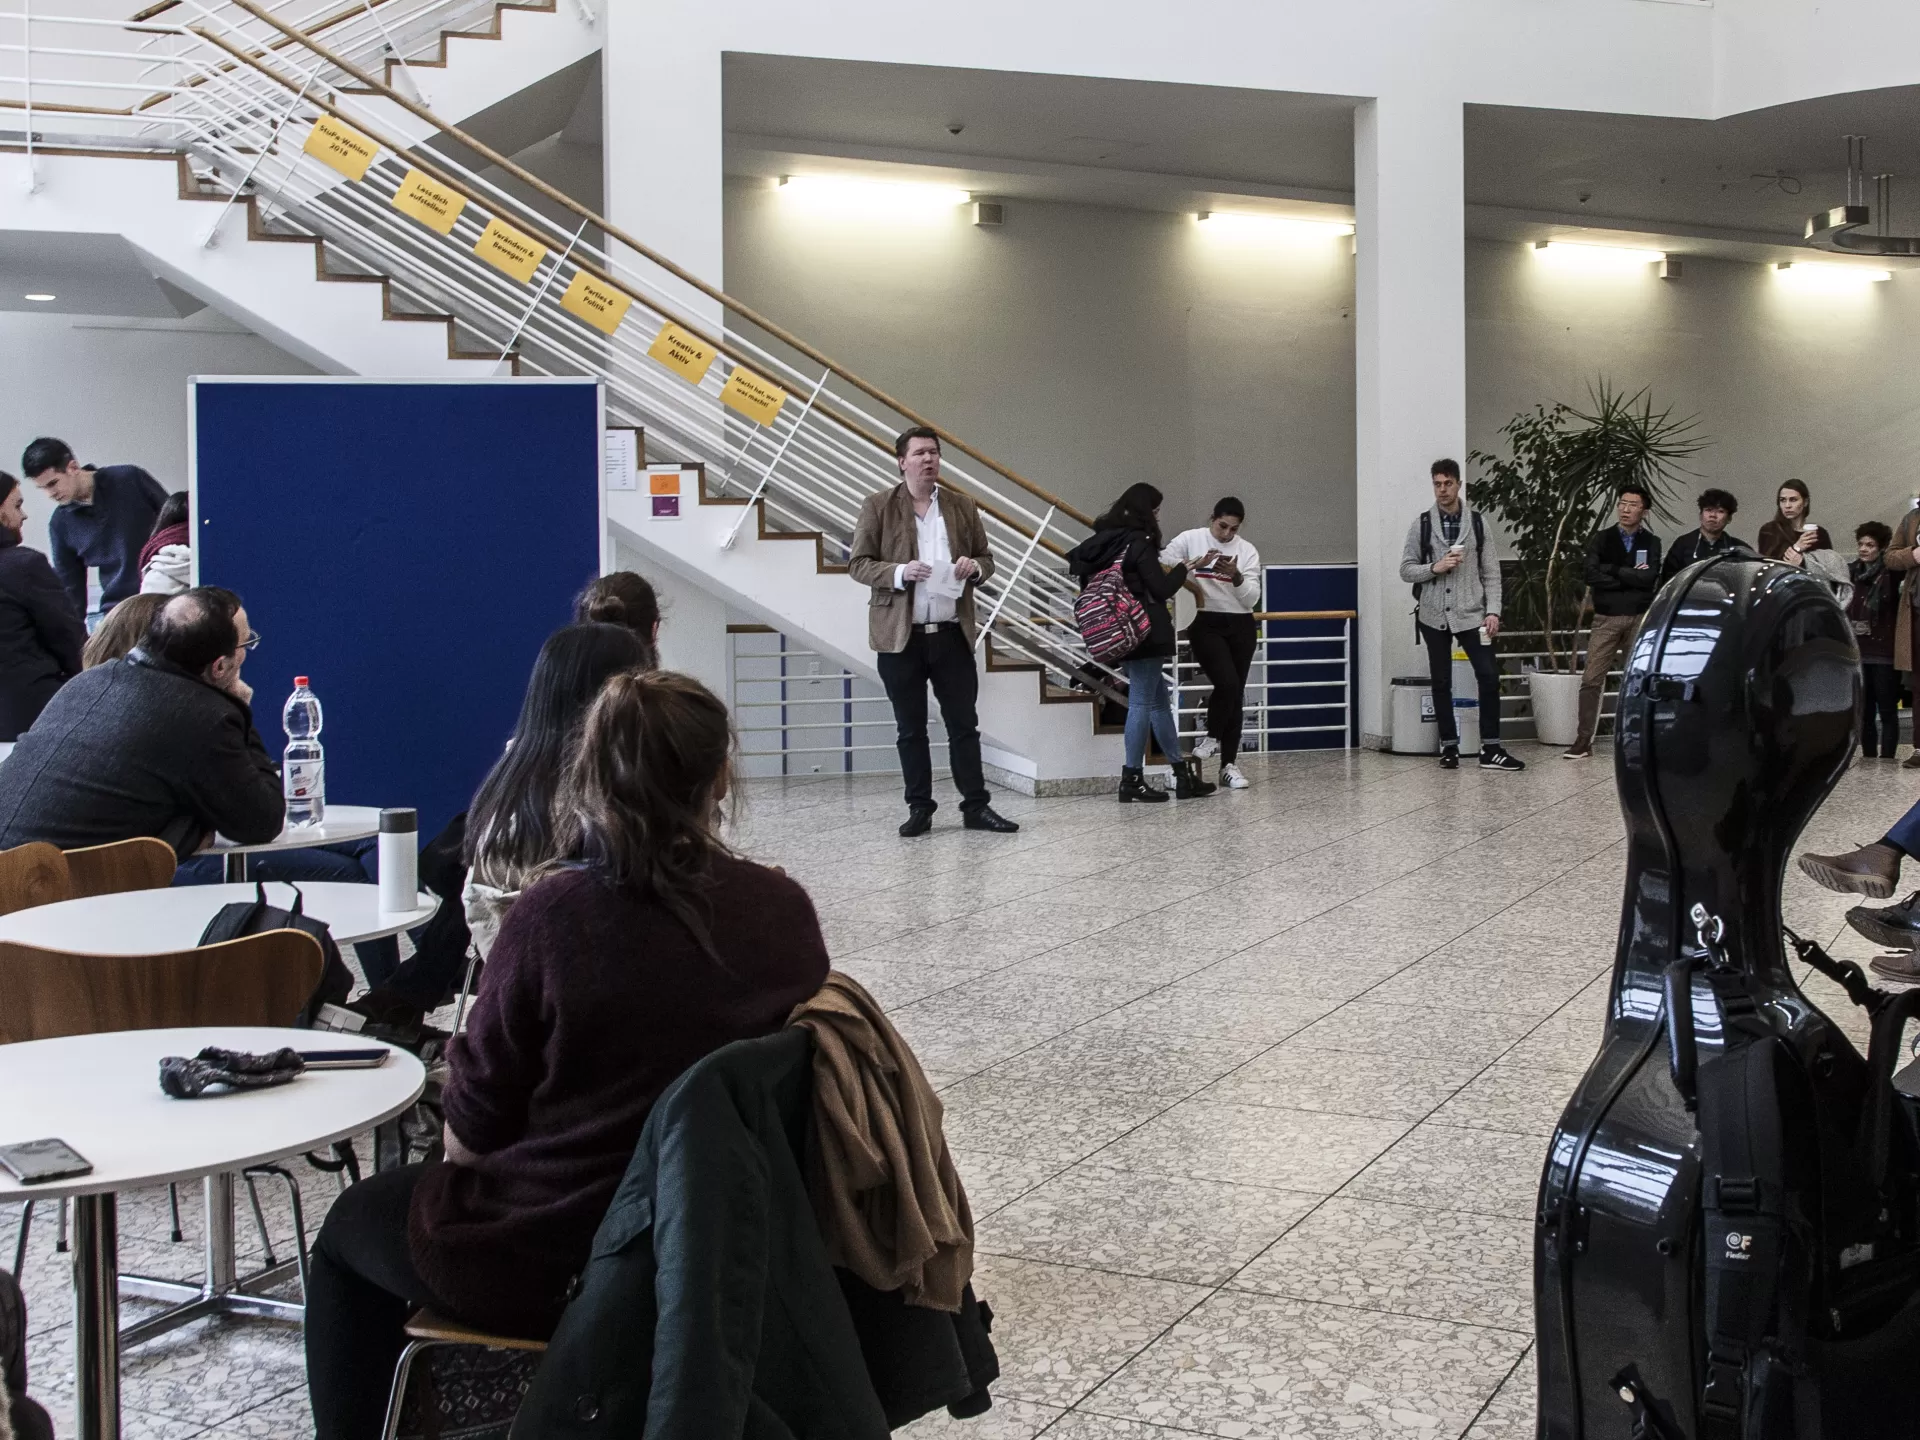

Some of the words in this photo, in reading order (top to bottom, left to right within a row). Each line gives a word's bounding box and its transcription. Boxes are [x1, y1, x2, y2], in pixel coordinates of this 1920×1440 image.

[318, 124, 369, 157] StuPa-Wahlen
[329, 143, 349, 157] 2018
[409, 192, 447, 216] aufstellen!
[416, 183, 433, 198] Lass
[432, 189, 449, 205] dich
[492, 229, 528, 255] Verändern
[528, 250, 535, 258] &
[492, 241, 524, 263] Bewegen
[582, 295, 606, 313] Politik
[584, 285, 608, 303] Parties
[667, 335, 694, 355] Kreativ
[668, 349, 690, 365] Aktiv
[735, 376, 755, 391] Macht
[754, 385, 765, 397] hat,
[766, 393, 778, 403] wer
[736, 387, 748, 397] was
[748, 392, 769, 408] macht!
